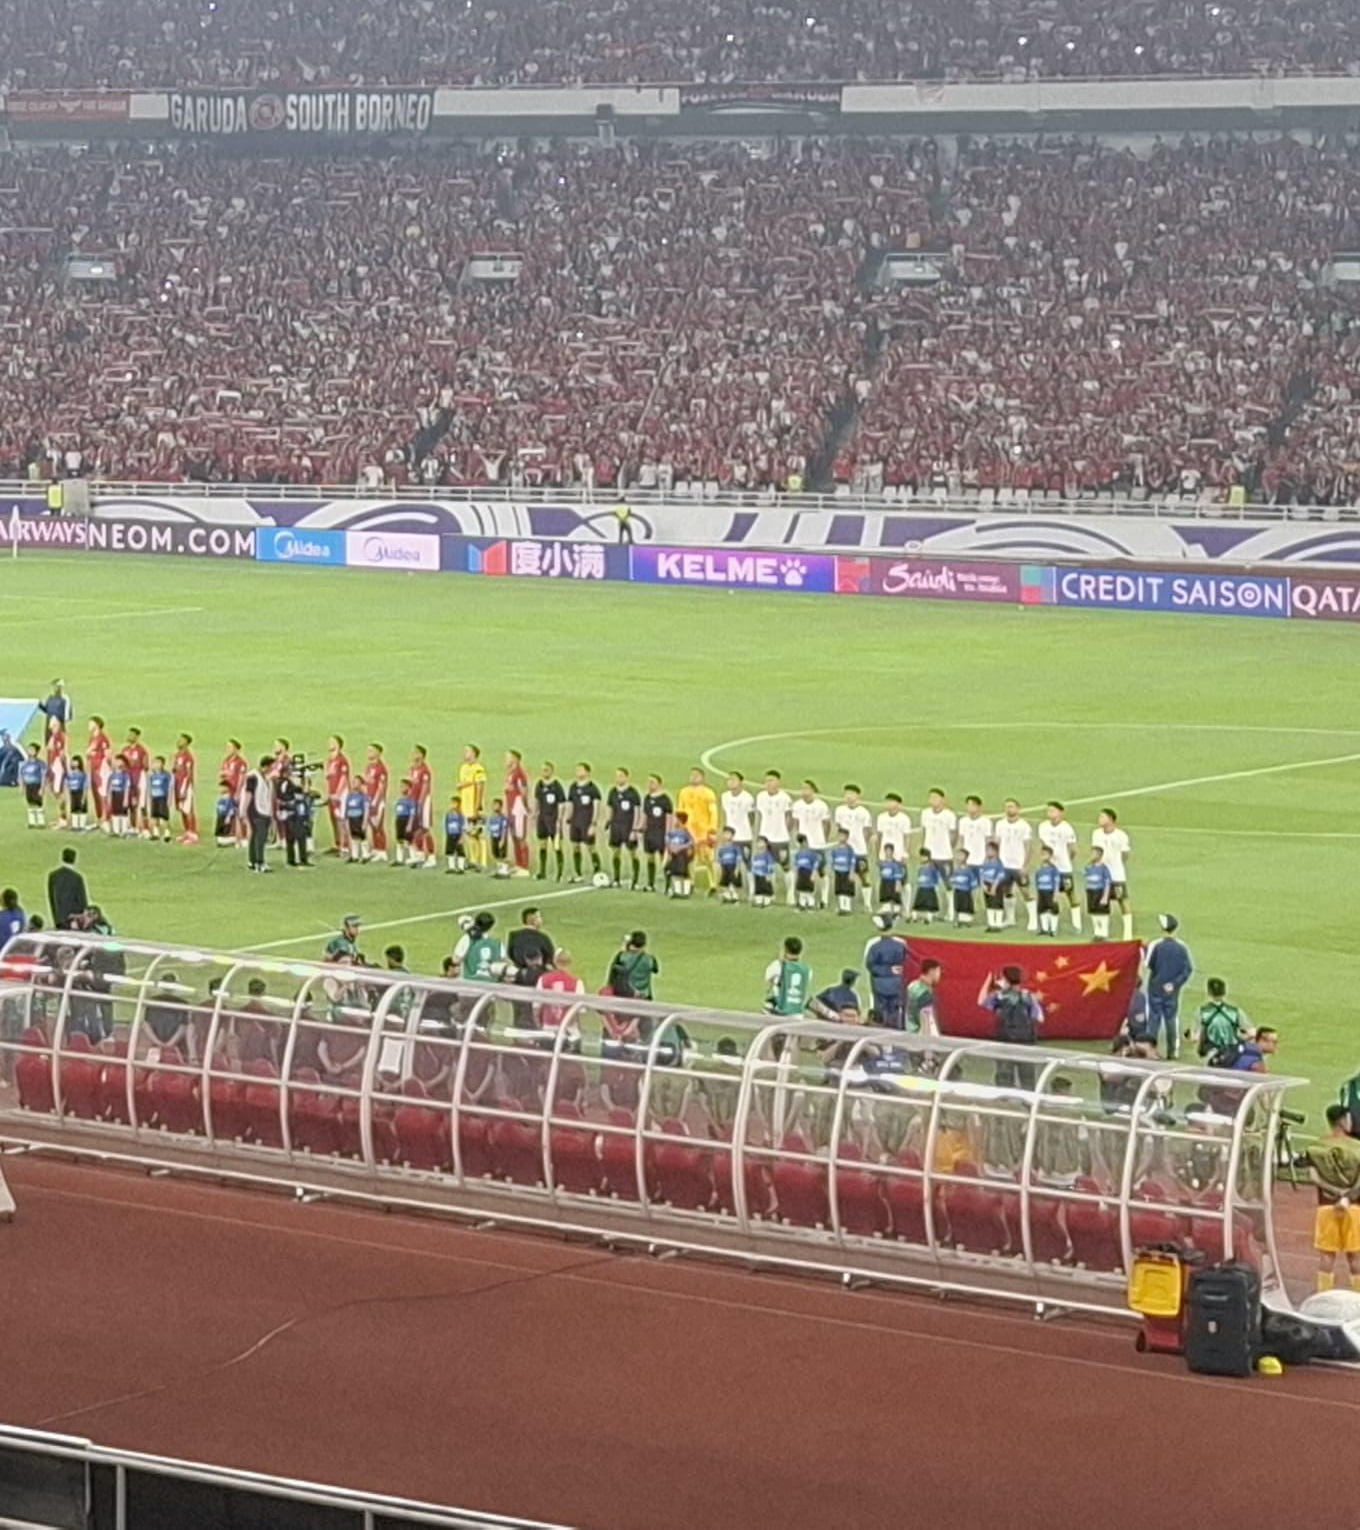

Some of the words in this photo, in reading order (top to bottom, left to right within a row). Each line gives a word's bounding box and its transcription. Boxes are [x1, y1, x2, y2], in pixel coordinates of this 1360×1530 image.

[171, 93, 248, 133] GARUDA
[286, 92, 349, 132] SOUTH
[356, 93, 431, 131] BORNEO
[88, 523, 255, 555] NEOM.COM
[279, 533, 330, 559] Midea
[369, 538, 421, 562] Midea
[658, 553, 778, 583] KELME
[1062, 573, 1163, 604] CREDIT
[1172, 578, 1283, 612] SAISON
